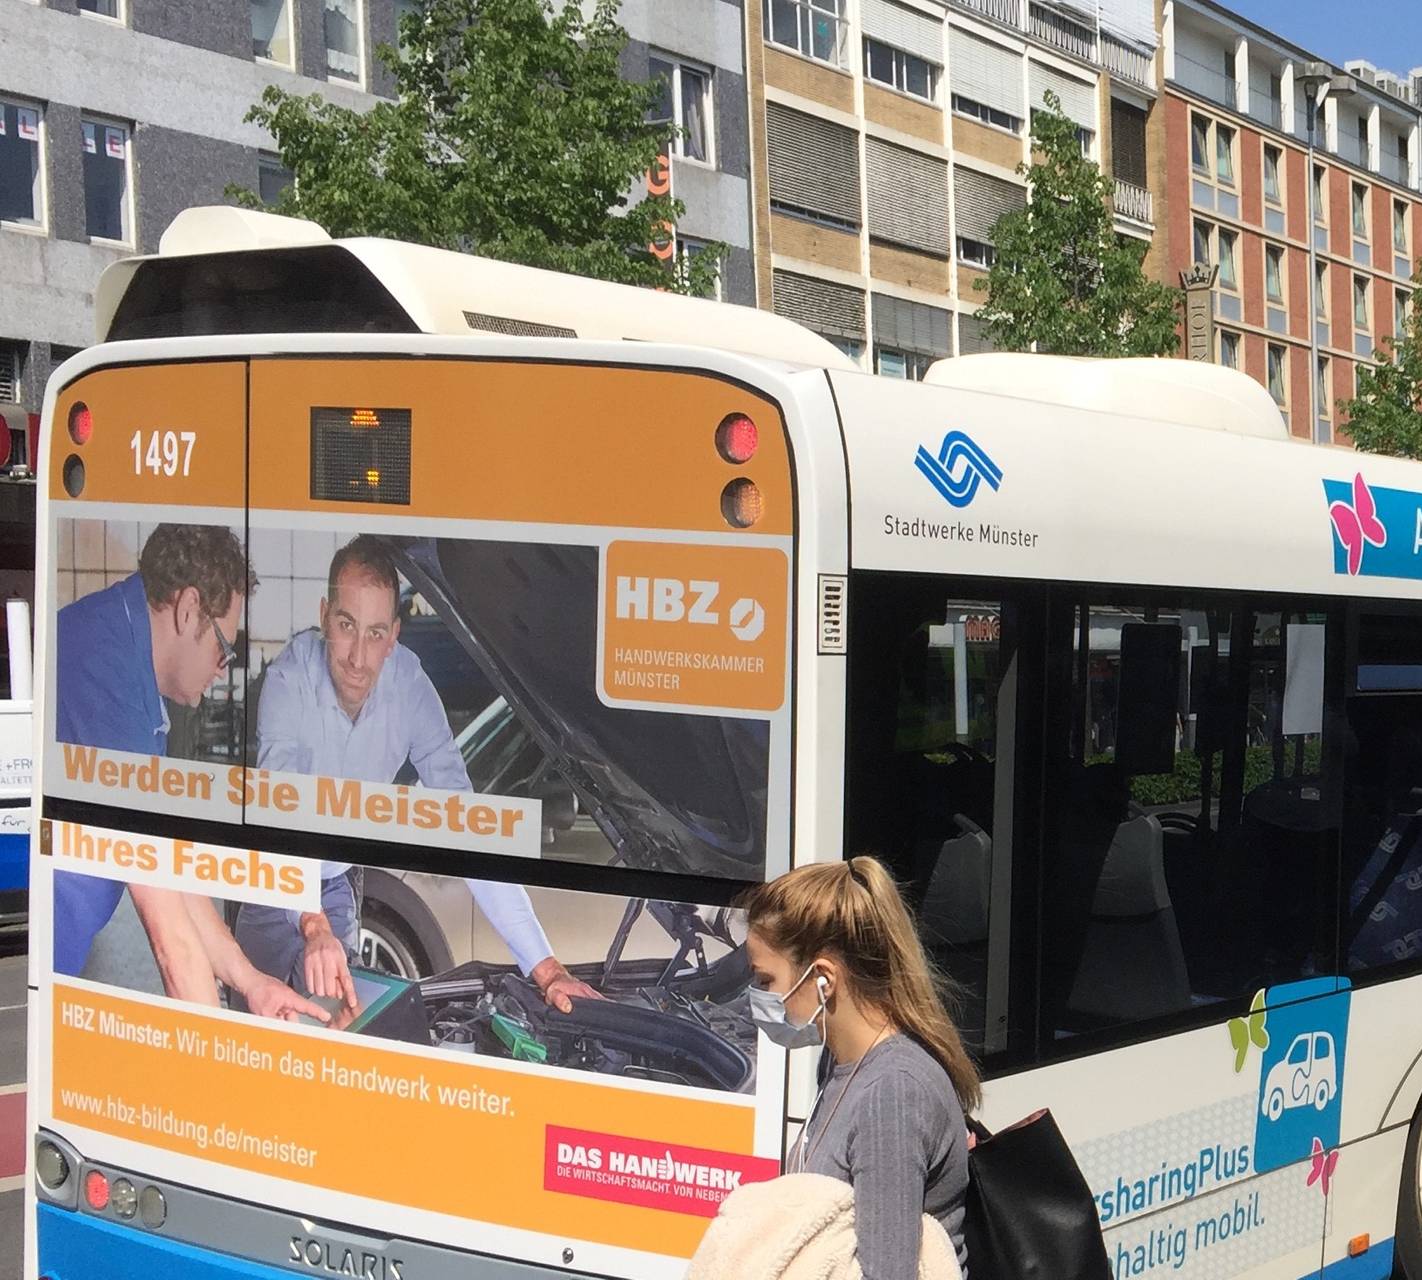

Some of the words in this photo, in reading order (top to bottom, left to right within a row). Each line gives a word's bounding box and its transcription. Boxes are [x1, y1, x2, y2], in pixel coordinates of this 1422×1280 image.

[130, 430, 197, 477] 1497
[884, 514, 974, 542] Stadtwerke
[979, 523, 1039, 548] Münster
[616, 575, 720, 625] HBZ
[614, 647, 765, 673] HANDWERKSKAMMER
[614, 667, 681, 690] MÜNSTER
[63, 745, 212, 800] Werden
[226, 764, 300, 812] Sie
[315, 775, 524, 838] Meister
[61, 821, 159, 872] Ihres
[172, 837, 306, 896] Fachs
[61, 1001, 95, 1033] HBZ
[99, 1010, 173, 1050] Münster.
[176, 1026, 208, 1057] Wir
[214, 1036, 273, 1072] bilden
[279, 1050, 315, 1080] das
[321, 1057, 431, 1103] Handwerk
[437, 1083, 515, 1117] weiter.
[61, 1088, 318, 1168] www.hbz-bildung.de/meister
[557, 1142, 603, 1170] DAS
[557, 1165, 572, 1178] DIE
[673, 1185, 694, 1199] VON
[1195, 1191, 1265, 1251] mobil.
[289, 1236, 404, 1280] SOLARIS
